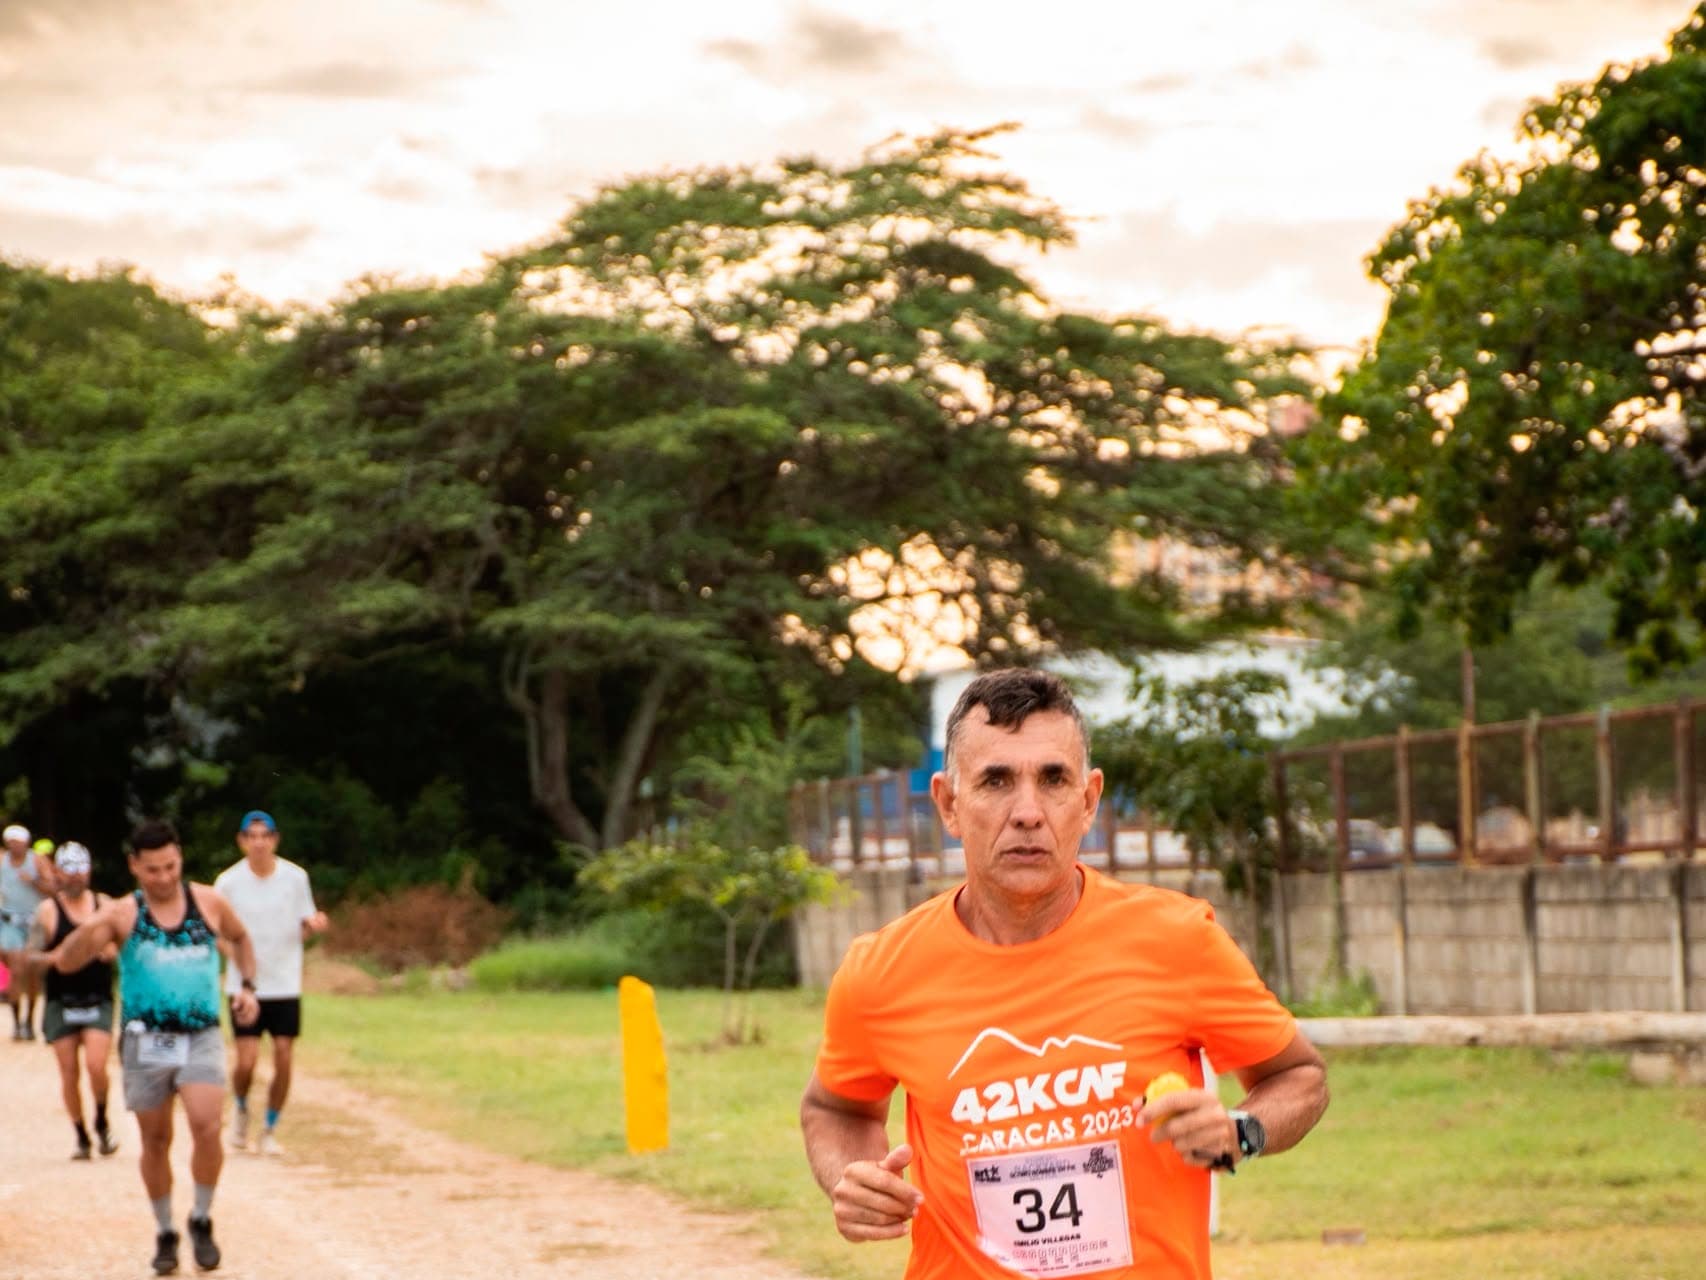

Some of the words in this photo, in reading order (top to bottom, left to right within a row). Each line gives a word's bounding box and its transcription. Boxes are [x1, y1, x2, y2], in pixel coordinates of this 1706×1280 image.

[960, 1117, 1076, 1156] CARACAS
[1081, 1105, 1135, 1138] 2023
[1013, 1182, 1083, 1234] 34
